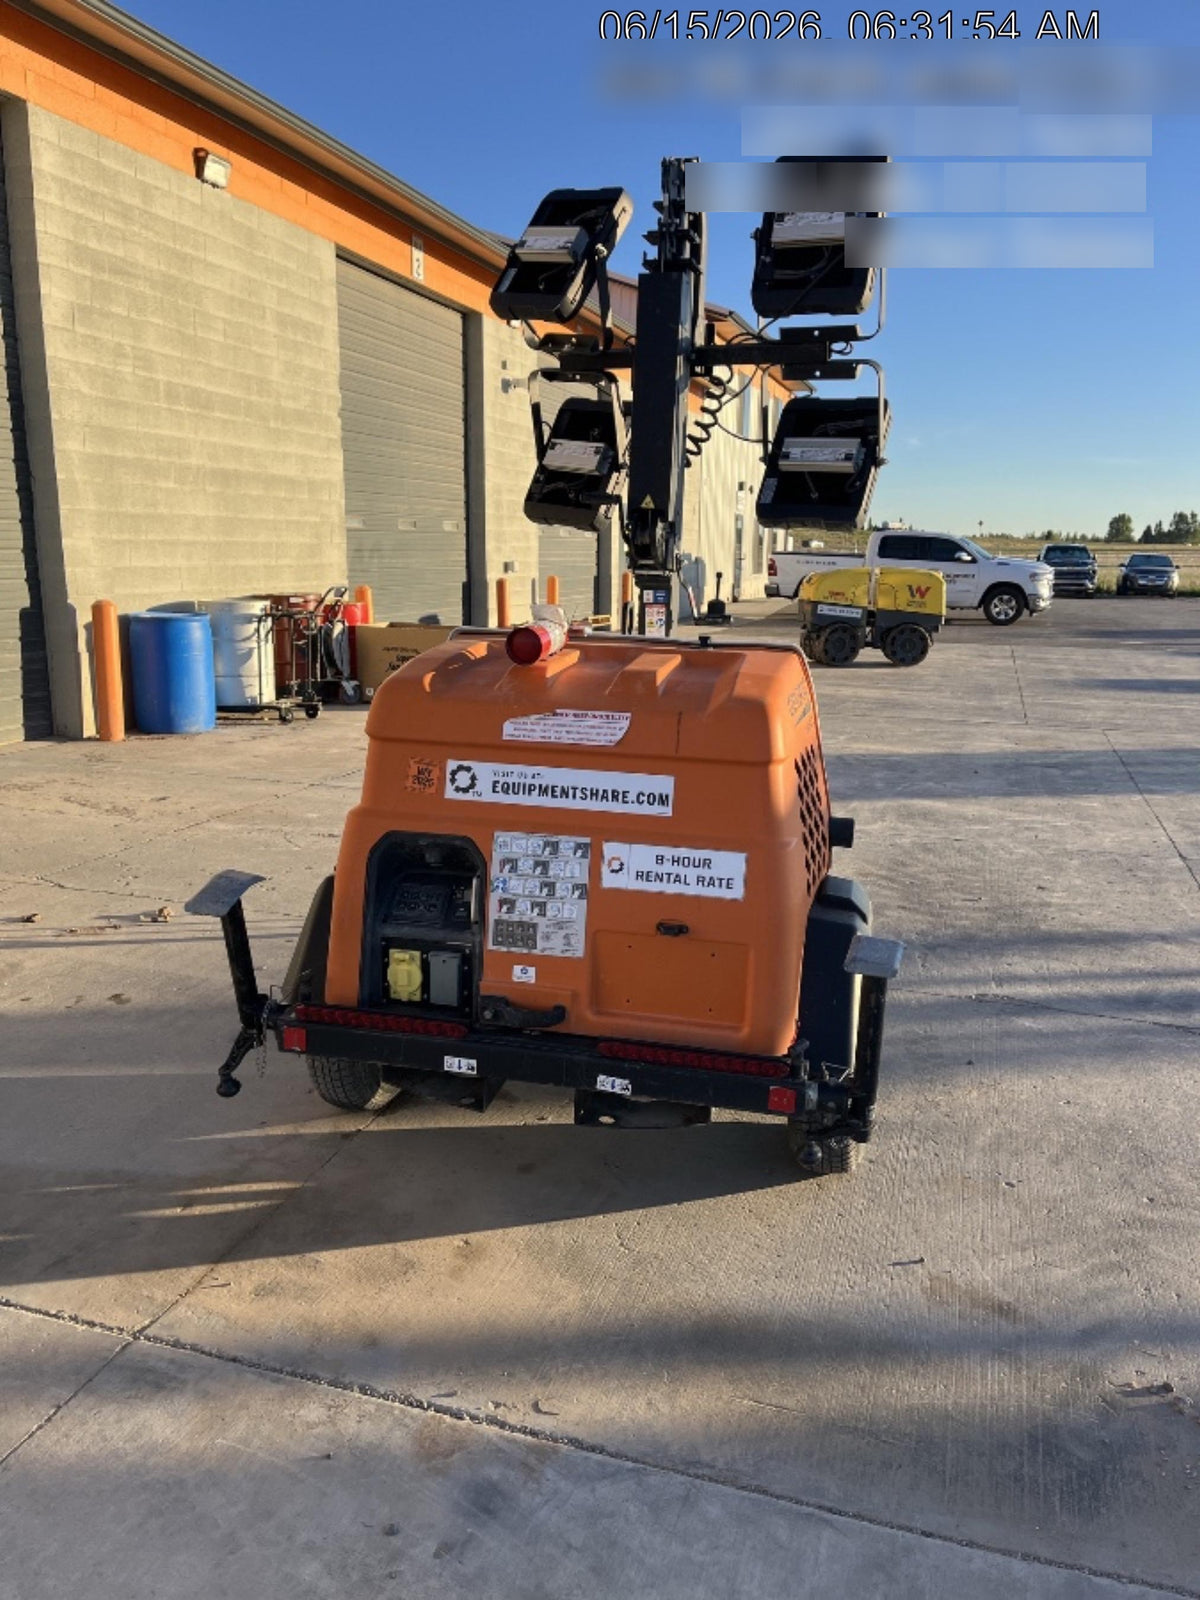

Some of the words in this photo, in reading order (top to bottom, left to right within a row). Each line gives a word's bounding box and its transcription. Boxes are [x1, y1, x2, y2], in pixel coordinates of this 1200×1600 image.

[491, 779, 670, 808] EQUIPMENTSHARE.COM
[635, 870, 691, 886] RENTAL
[696, 875, 735, 890] RATE
